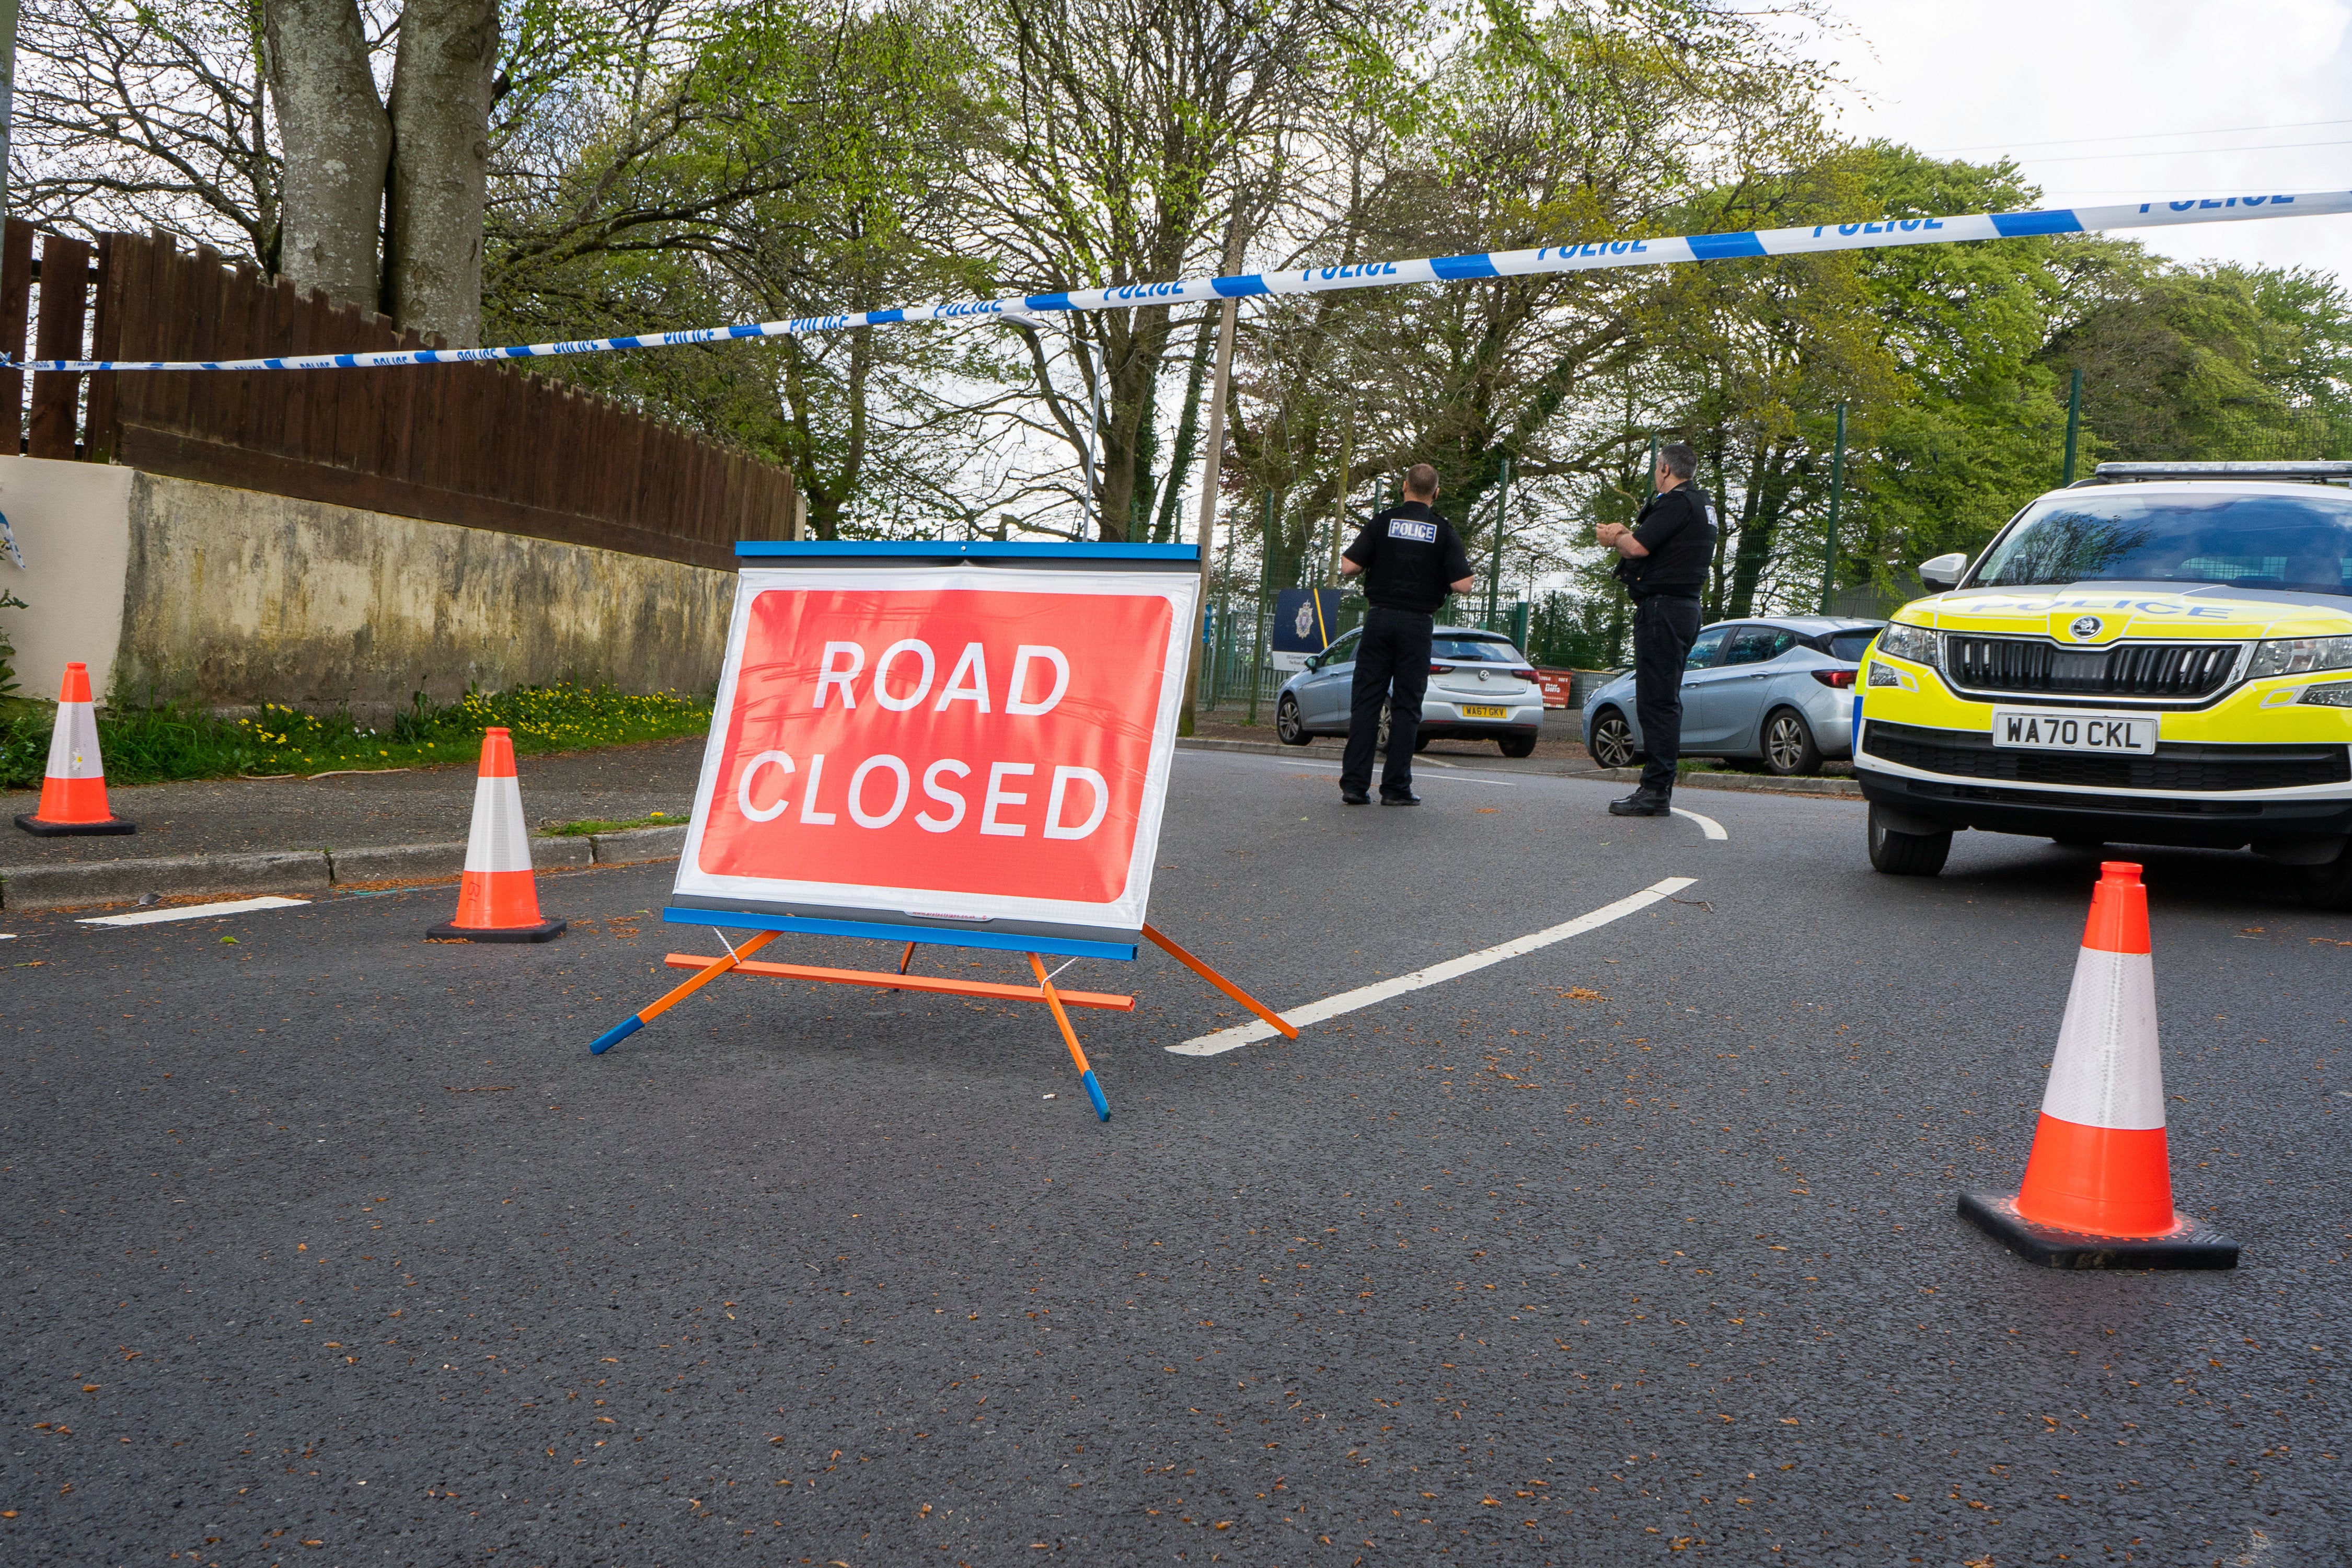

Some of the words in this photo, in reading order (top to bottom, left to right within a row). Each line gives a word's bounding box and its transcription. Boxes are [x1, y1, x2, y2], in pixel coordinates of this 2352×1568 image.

[1391, 522, 1434, 539] POLICE
[1969, 600, 2234, 619] POLICE
[813, 639, 1070, 716] ROAD
[1466, 707, 1487, 715] WA67
[1489, 708, 1504, 716] GKV
[2007, 718, 2078, 744] WA70
[2088, 721, 2141, 748] CKL
[738, 750, 1109, 840] CLOSED
